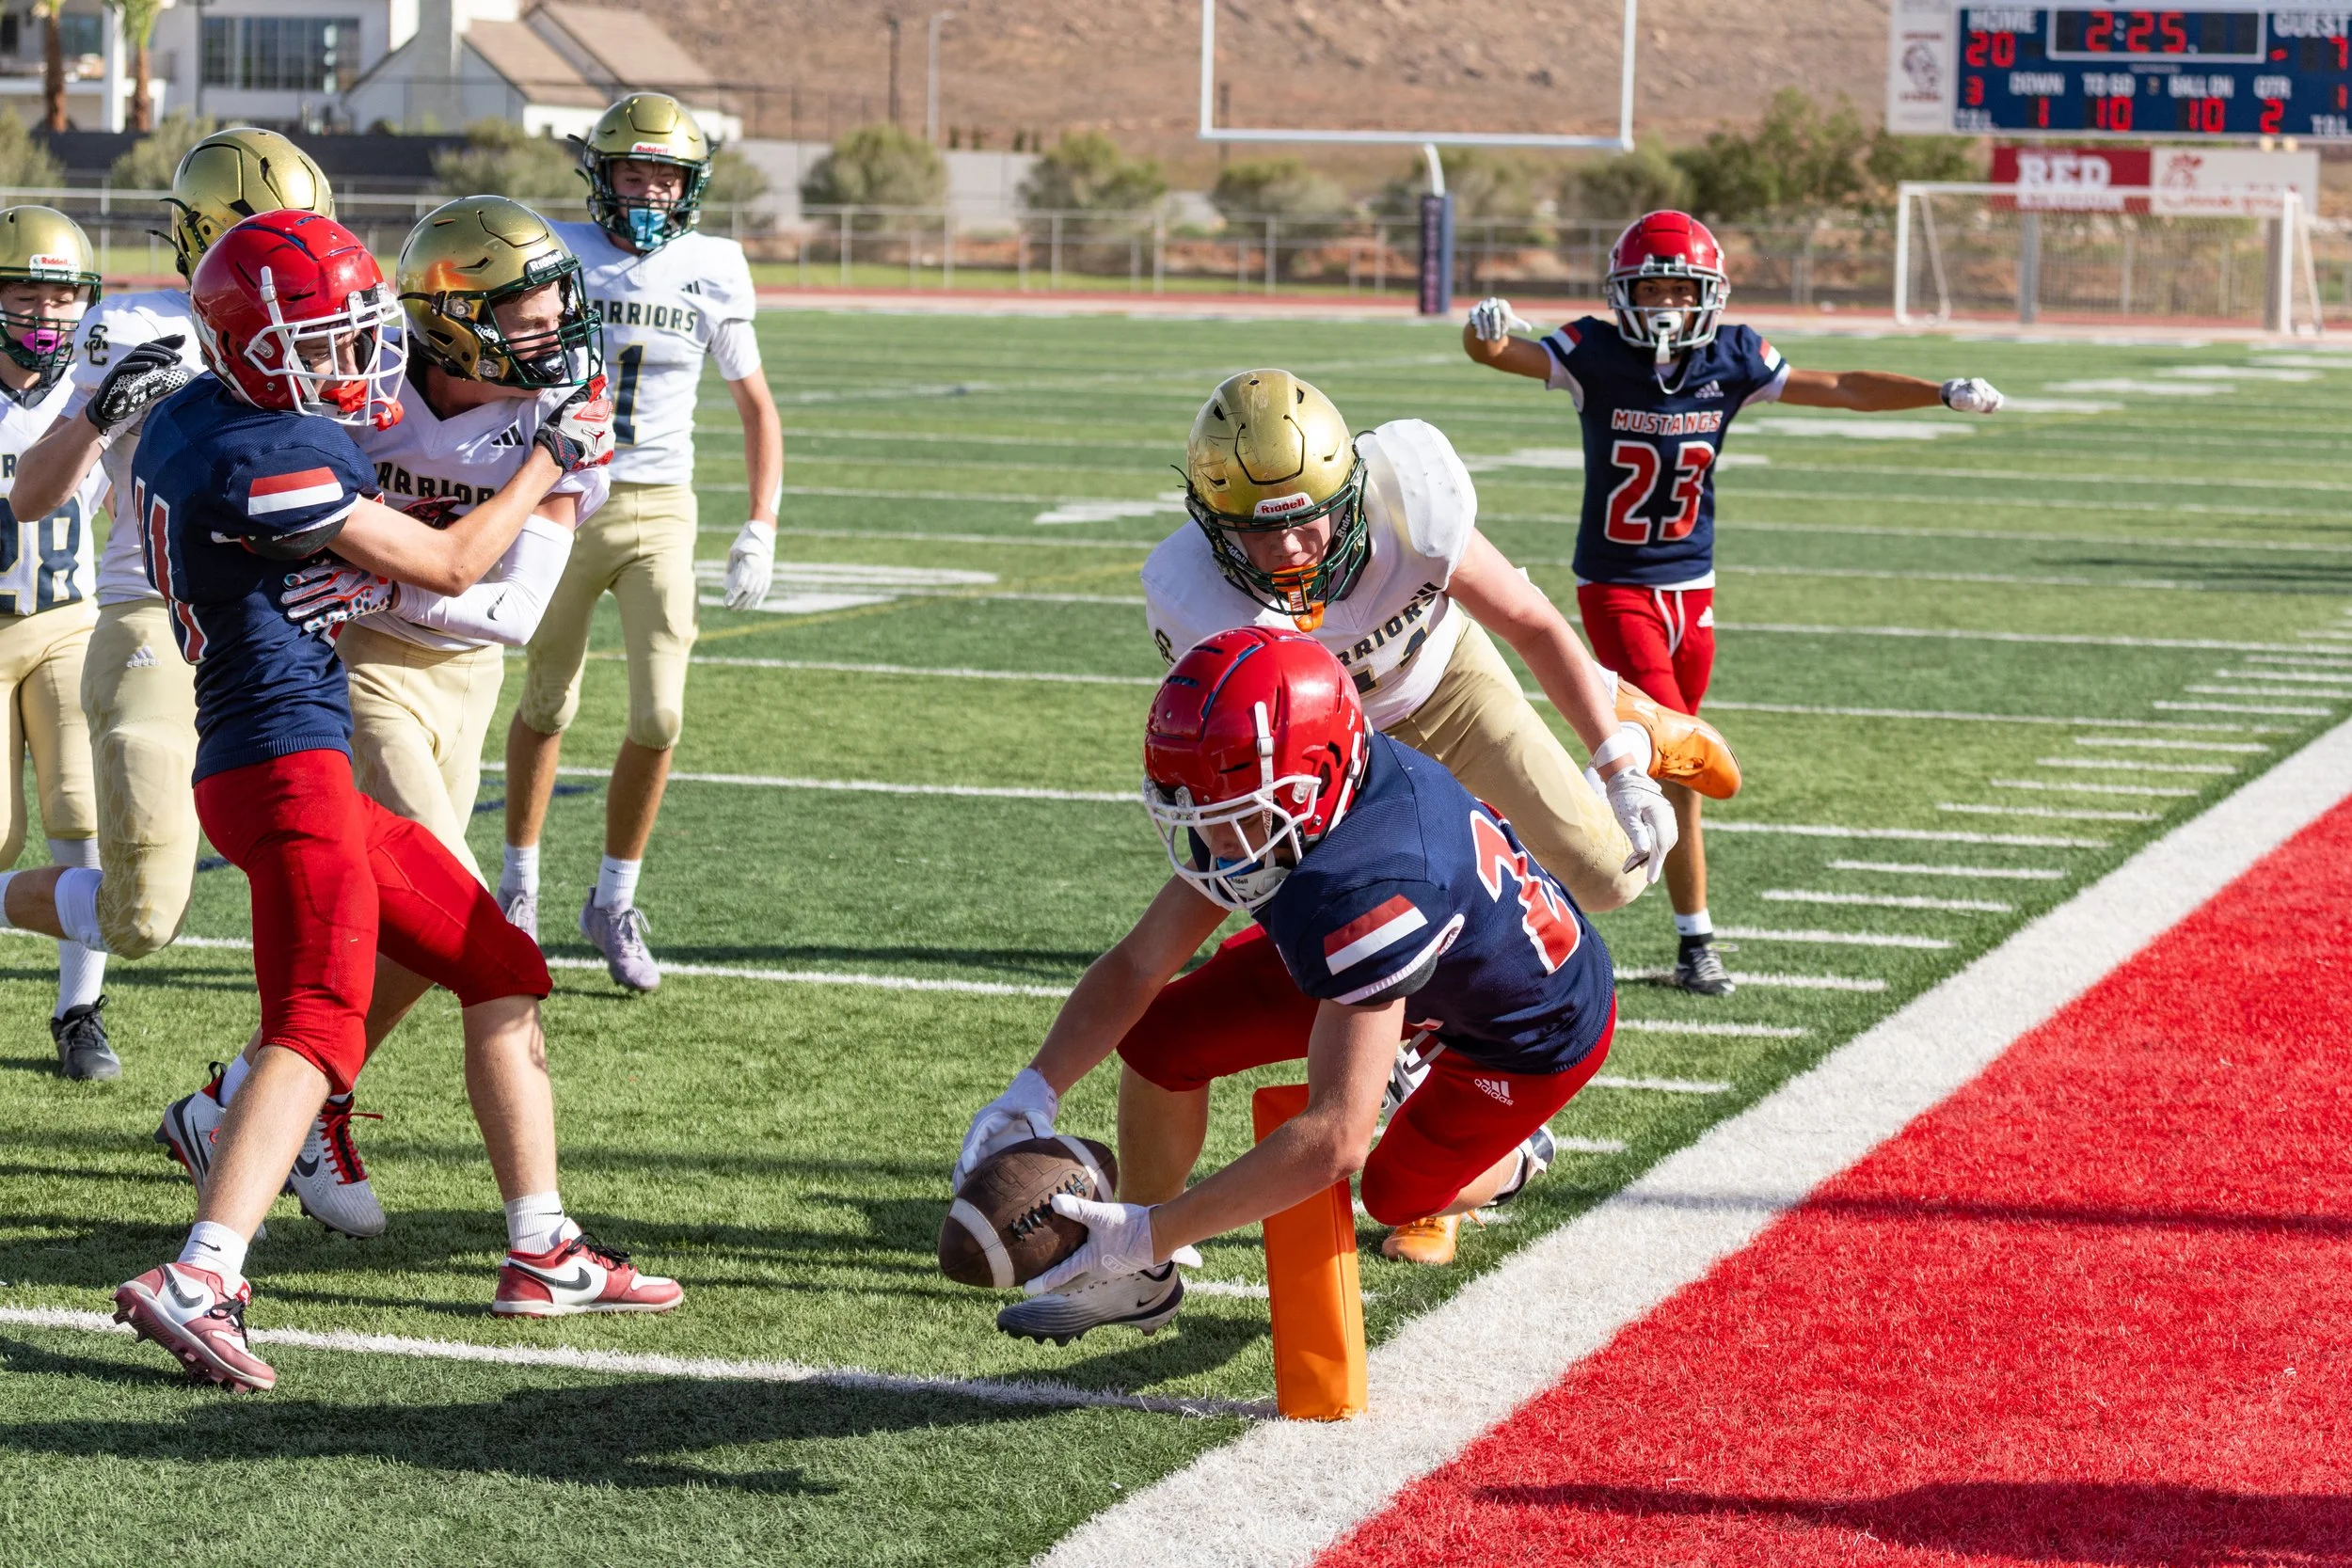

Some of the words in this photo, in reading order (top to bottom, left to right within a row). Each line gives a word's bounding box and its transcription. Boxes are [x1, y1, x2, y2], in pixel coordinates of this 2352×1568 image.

[1967, 10, 2037, 33] HOME
[2273, 12, 2351, 38] GUEST
[1965, 30, 2015, 67] 20
[2328, 35, 2348, 70] 7
[1965, 75, 1984, 105] 3
[2009, 72, 2064, 96] DOWN
[2082, 73, 2106, 96] TO
[2108, 73, 2136, 96] GO
[2168, 74, 2207, 98] BALL
[2208, 75, 2234, 98] ON
[2253, 75, 2292, 99] QTR
[2038, 96, 2049, 128] 1
[2096, 95, 2133, 132] 10
[2188, 97, 2225, 134] 10
[2260, 98, 2284, 134] 2
[2016, 155, 2112, 190] RED
[529, 250, 564, 272] Riddell
[592, 300, 697, 332] ARRIORS
[613, 341, 646, 449] 1
[1612, 408, 1724, 436] MUSTANGS
[1261, 497, 1306, 514] Riddell
[1604, 439, 1716, 546] 23
[1474, 1078, 1514, 1106] adidas
